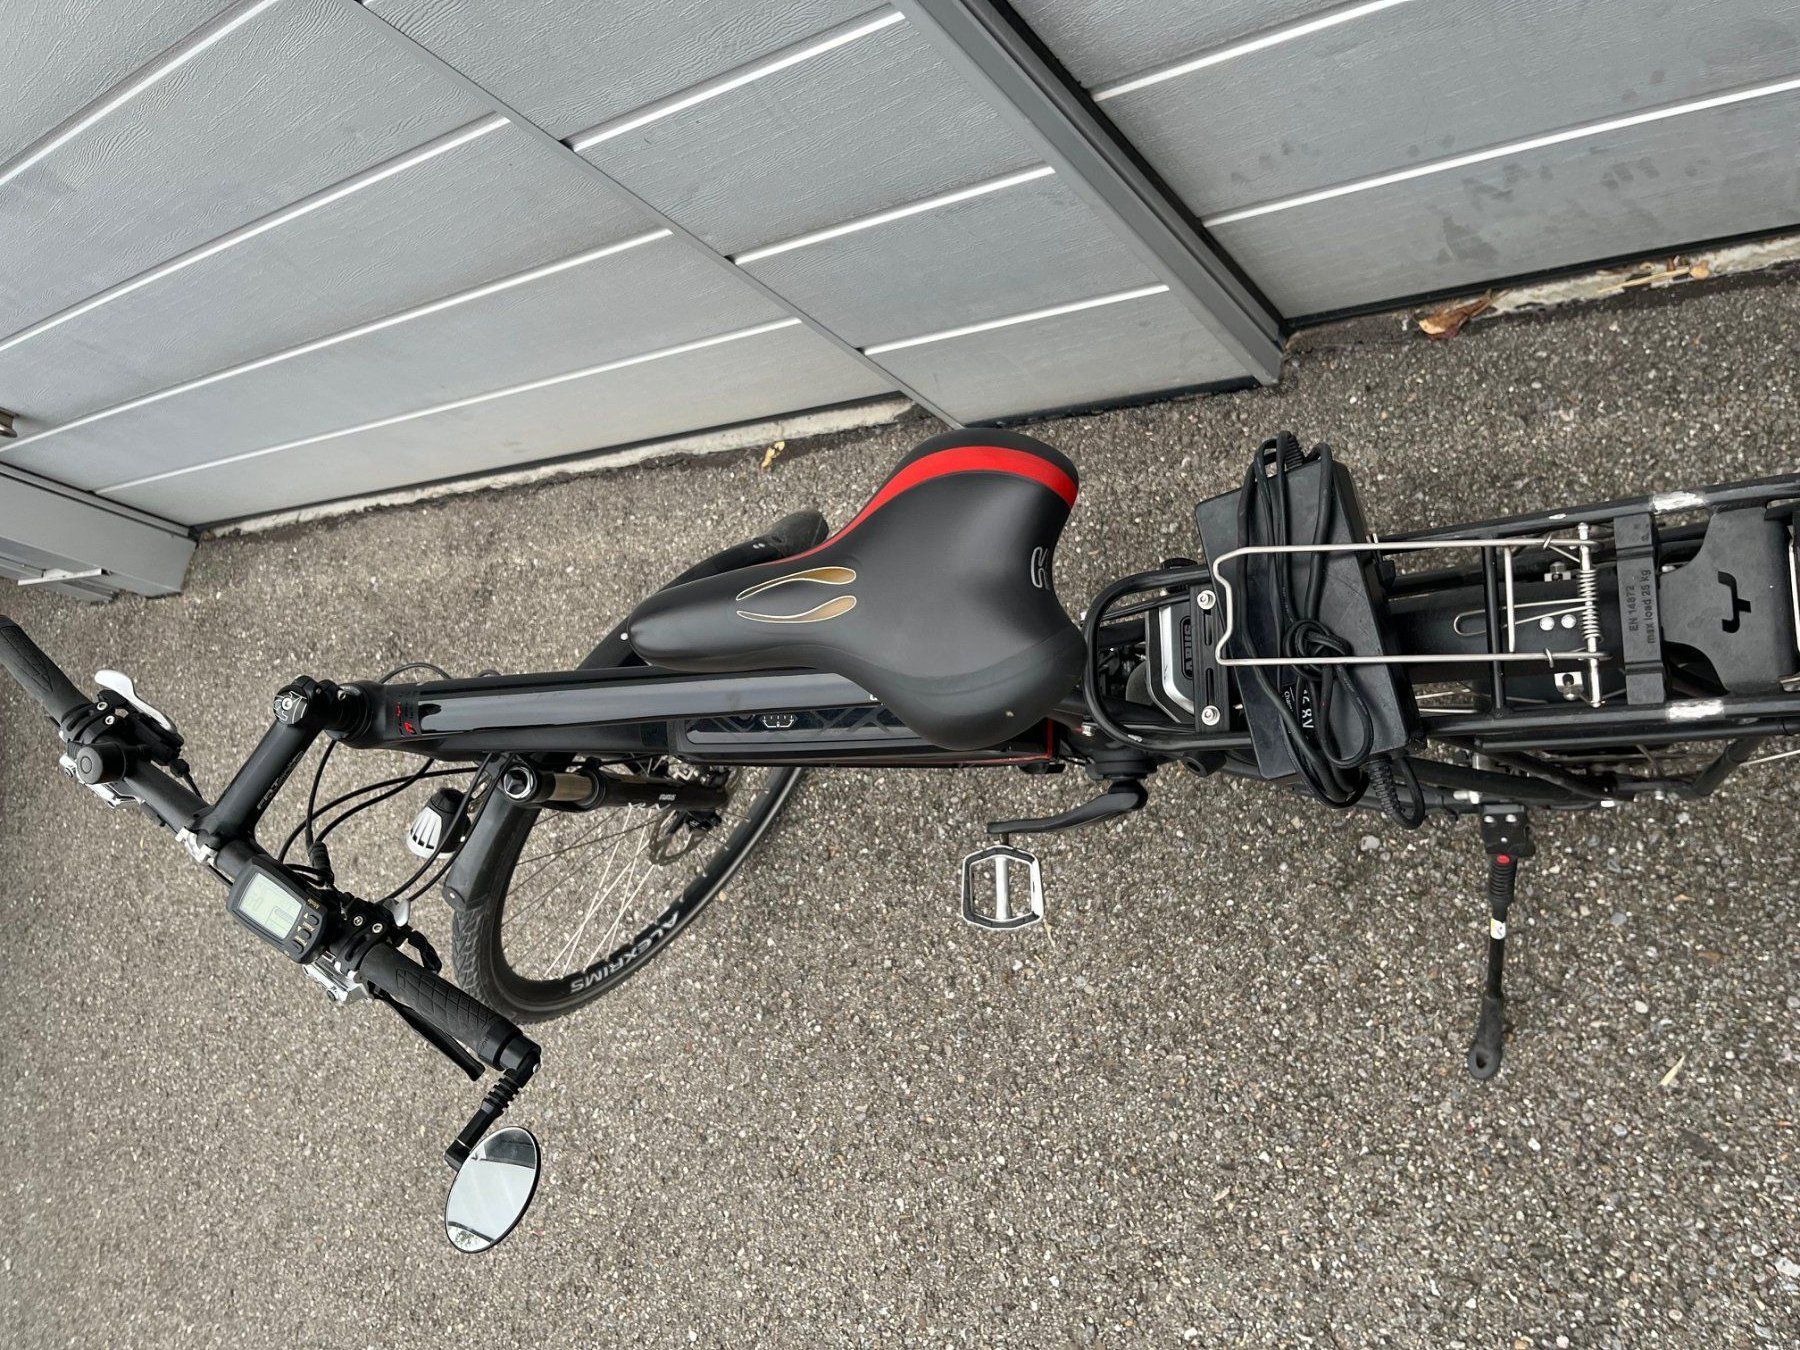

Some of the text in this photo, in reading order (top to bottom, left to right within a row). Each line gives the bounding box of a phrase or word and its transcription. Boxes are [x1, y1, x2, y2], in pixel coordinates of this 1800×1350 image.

[1641, 584, 1651, 597] 25
[1642, 599, 1653, 621] load
[1629, 618, 1640, 631] EN
[1646, 623, 1656, 643] max
[571, 911, 679, 992] ALEXRIMS
